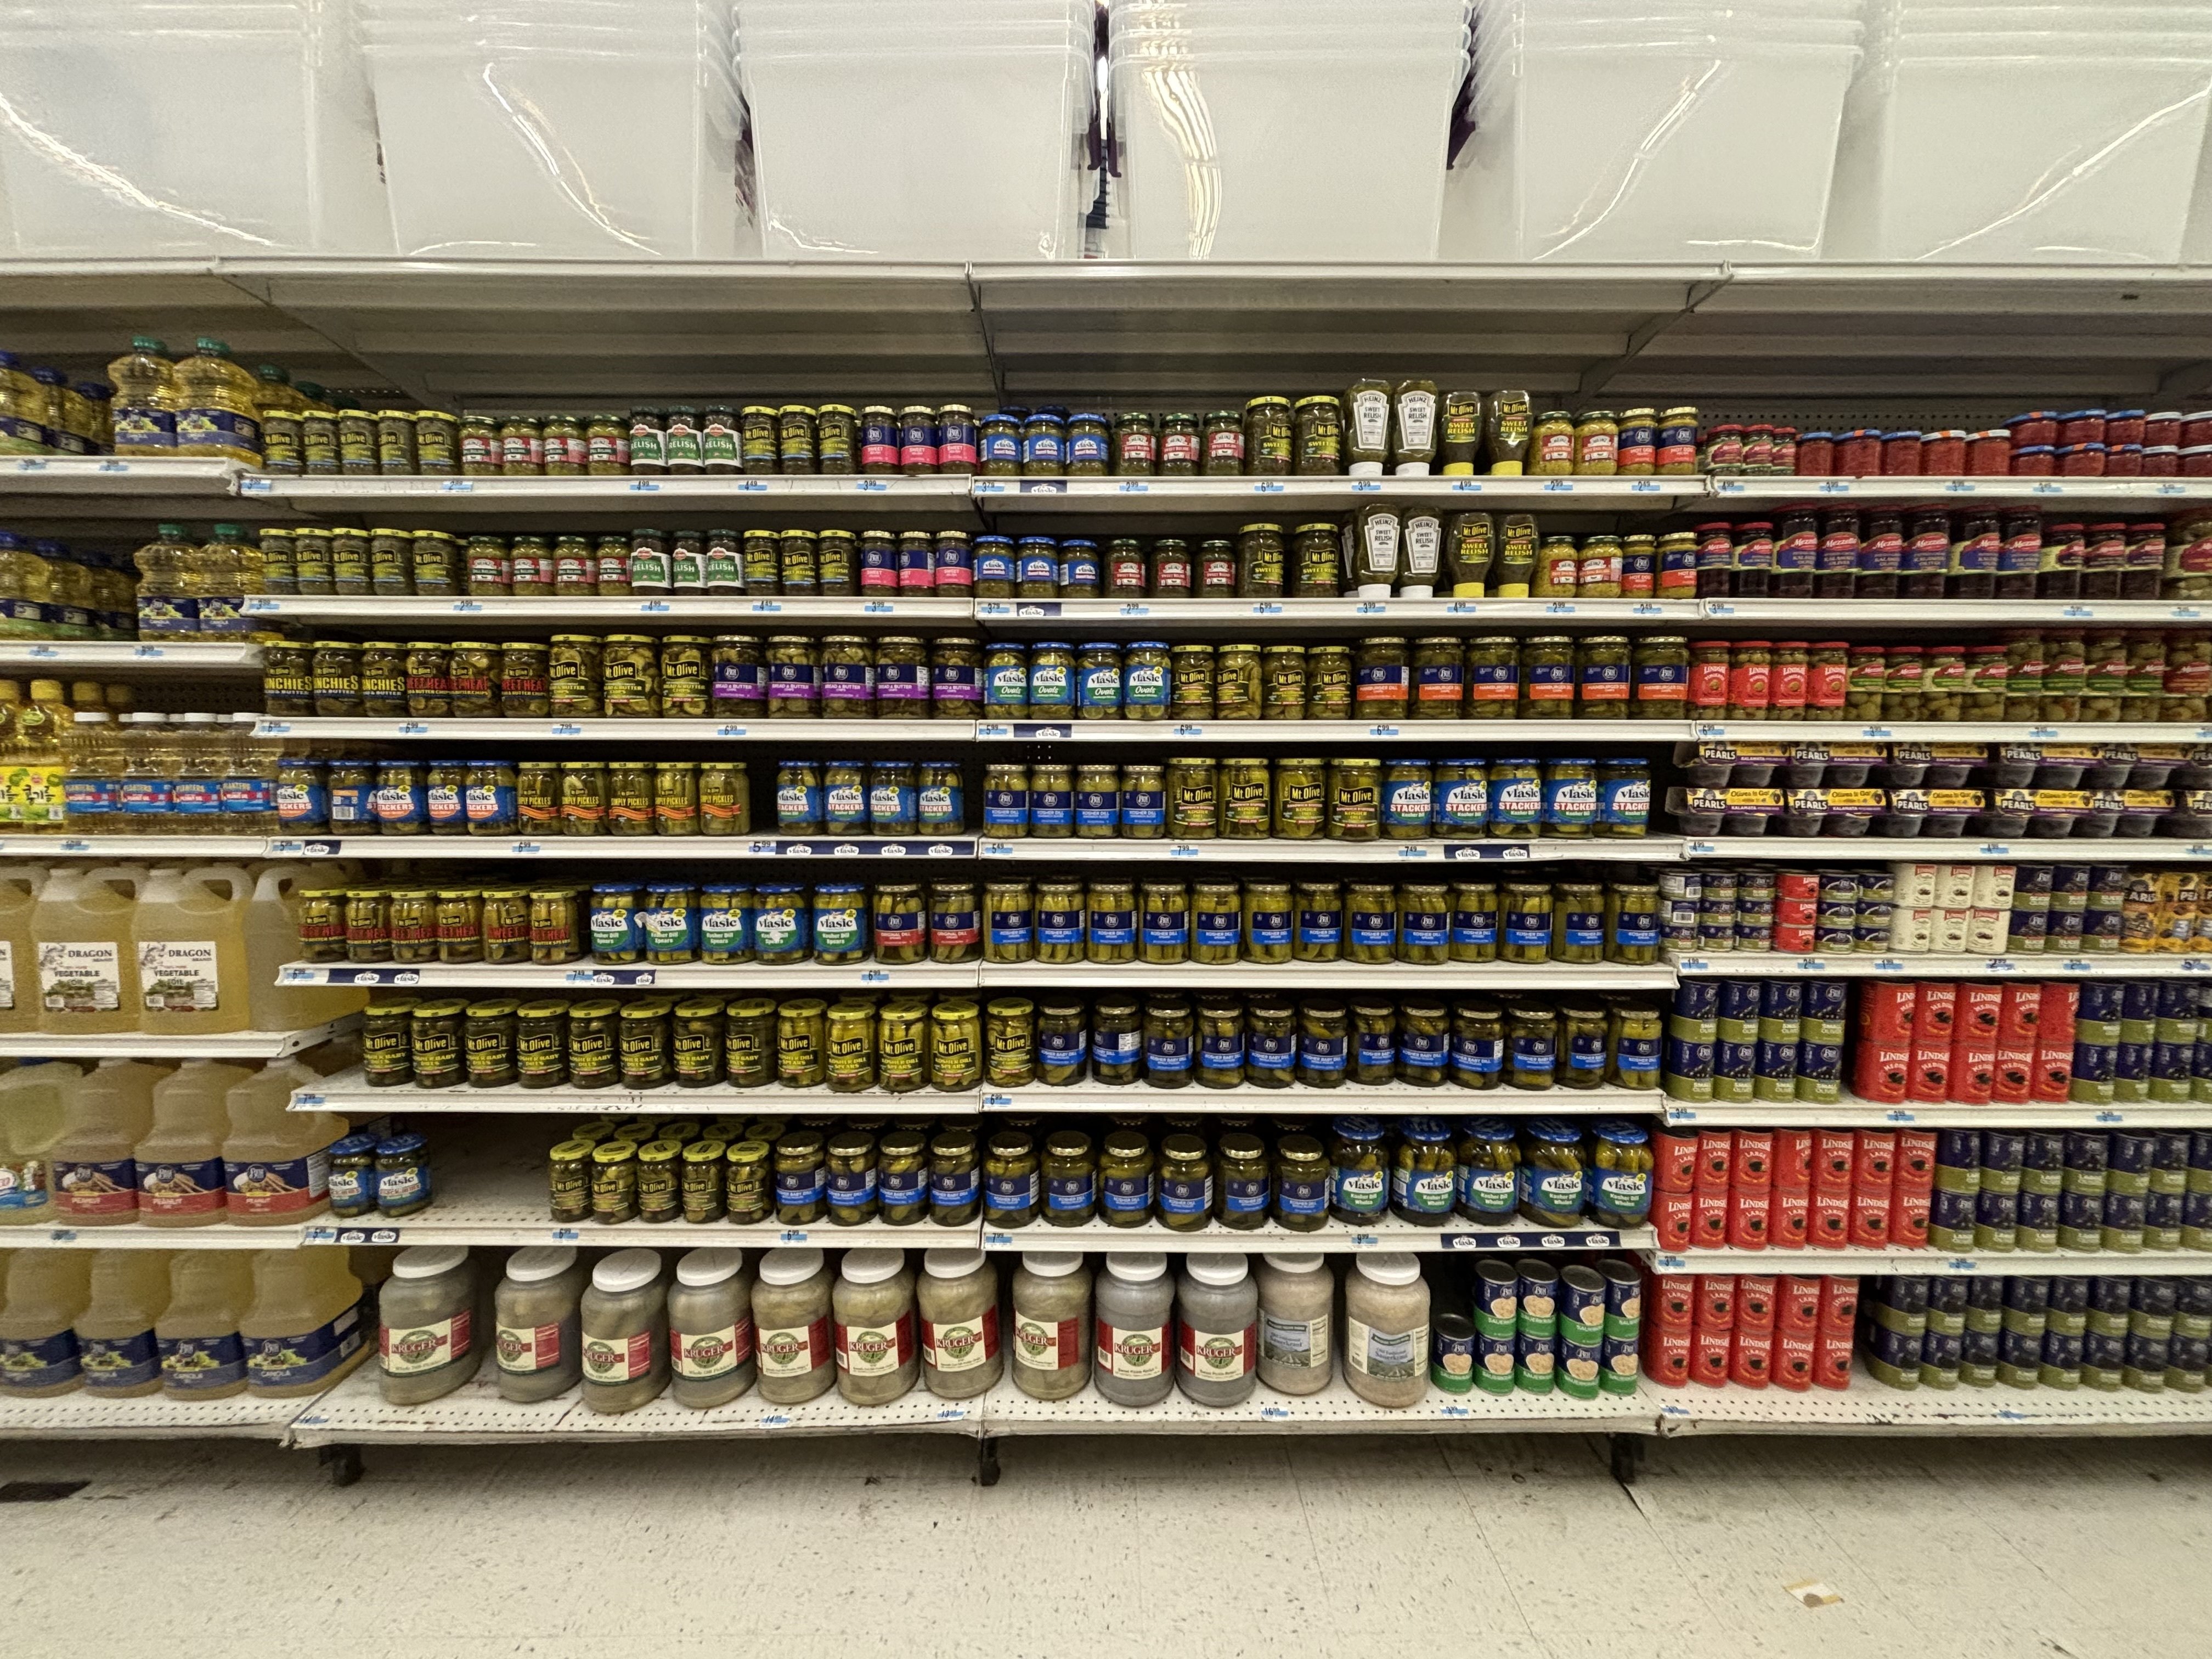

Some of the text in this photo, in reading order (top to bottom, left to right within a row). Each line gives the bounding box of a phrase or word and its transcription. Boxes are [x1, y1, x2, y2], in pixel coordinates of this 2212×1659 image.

[1459, 404, 1474, 414] Olive
[1511, 403, 1526, 413] Olive
[669, 441, 696, 450] RELISH
[706, 441, 732, 450] RELISH
[1471, 526, 1487, 535] Olive
[613, 664, 633, 675] Olive
[677, 663, 697, 674] Olive
[1189, 673, 1204, 681] Olive
[1096, 687, 1114, 696] Ovals
[1136, 686, 1155, 694] Ovals
[1705, 751, 1736, 760] PEARLS
[1797, 751, 1829, 760] PEARLS
[1899, 751, 1931, 760] PEARLS
[1196, 789, 1212, 799] Olive
[1245, 787, 1262, 797] Olive
[1352, 791, 1371, 800] Olive
[628, 797, 648, 805] PICKLES
[1694, 799, 1725, 808] PEARLS
[1795, 799, 1827, 809] PEARLS
[583, 1041, 602, 1051] Olive
[842, 1042, 861, 1052] Olive
[895, 1042, 913, 1052] Olive
[949, 1042, 967, 1052] Olive
[392, 1340, 437, 1352] KRUGER
[849, 1341, 888, 1351] KRUGER
[936, 1337, 974, 1347] KRUGER
[684, 1346, 723, 1358] KRUGER
[761, 1344, 798, 1352] KRUGER
[1115, 1344, 1152, 1355] KRUGER
[1197, 1346, 1234, 1356] KRUGER
